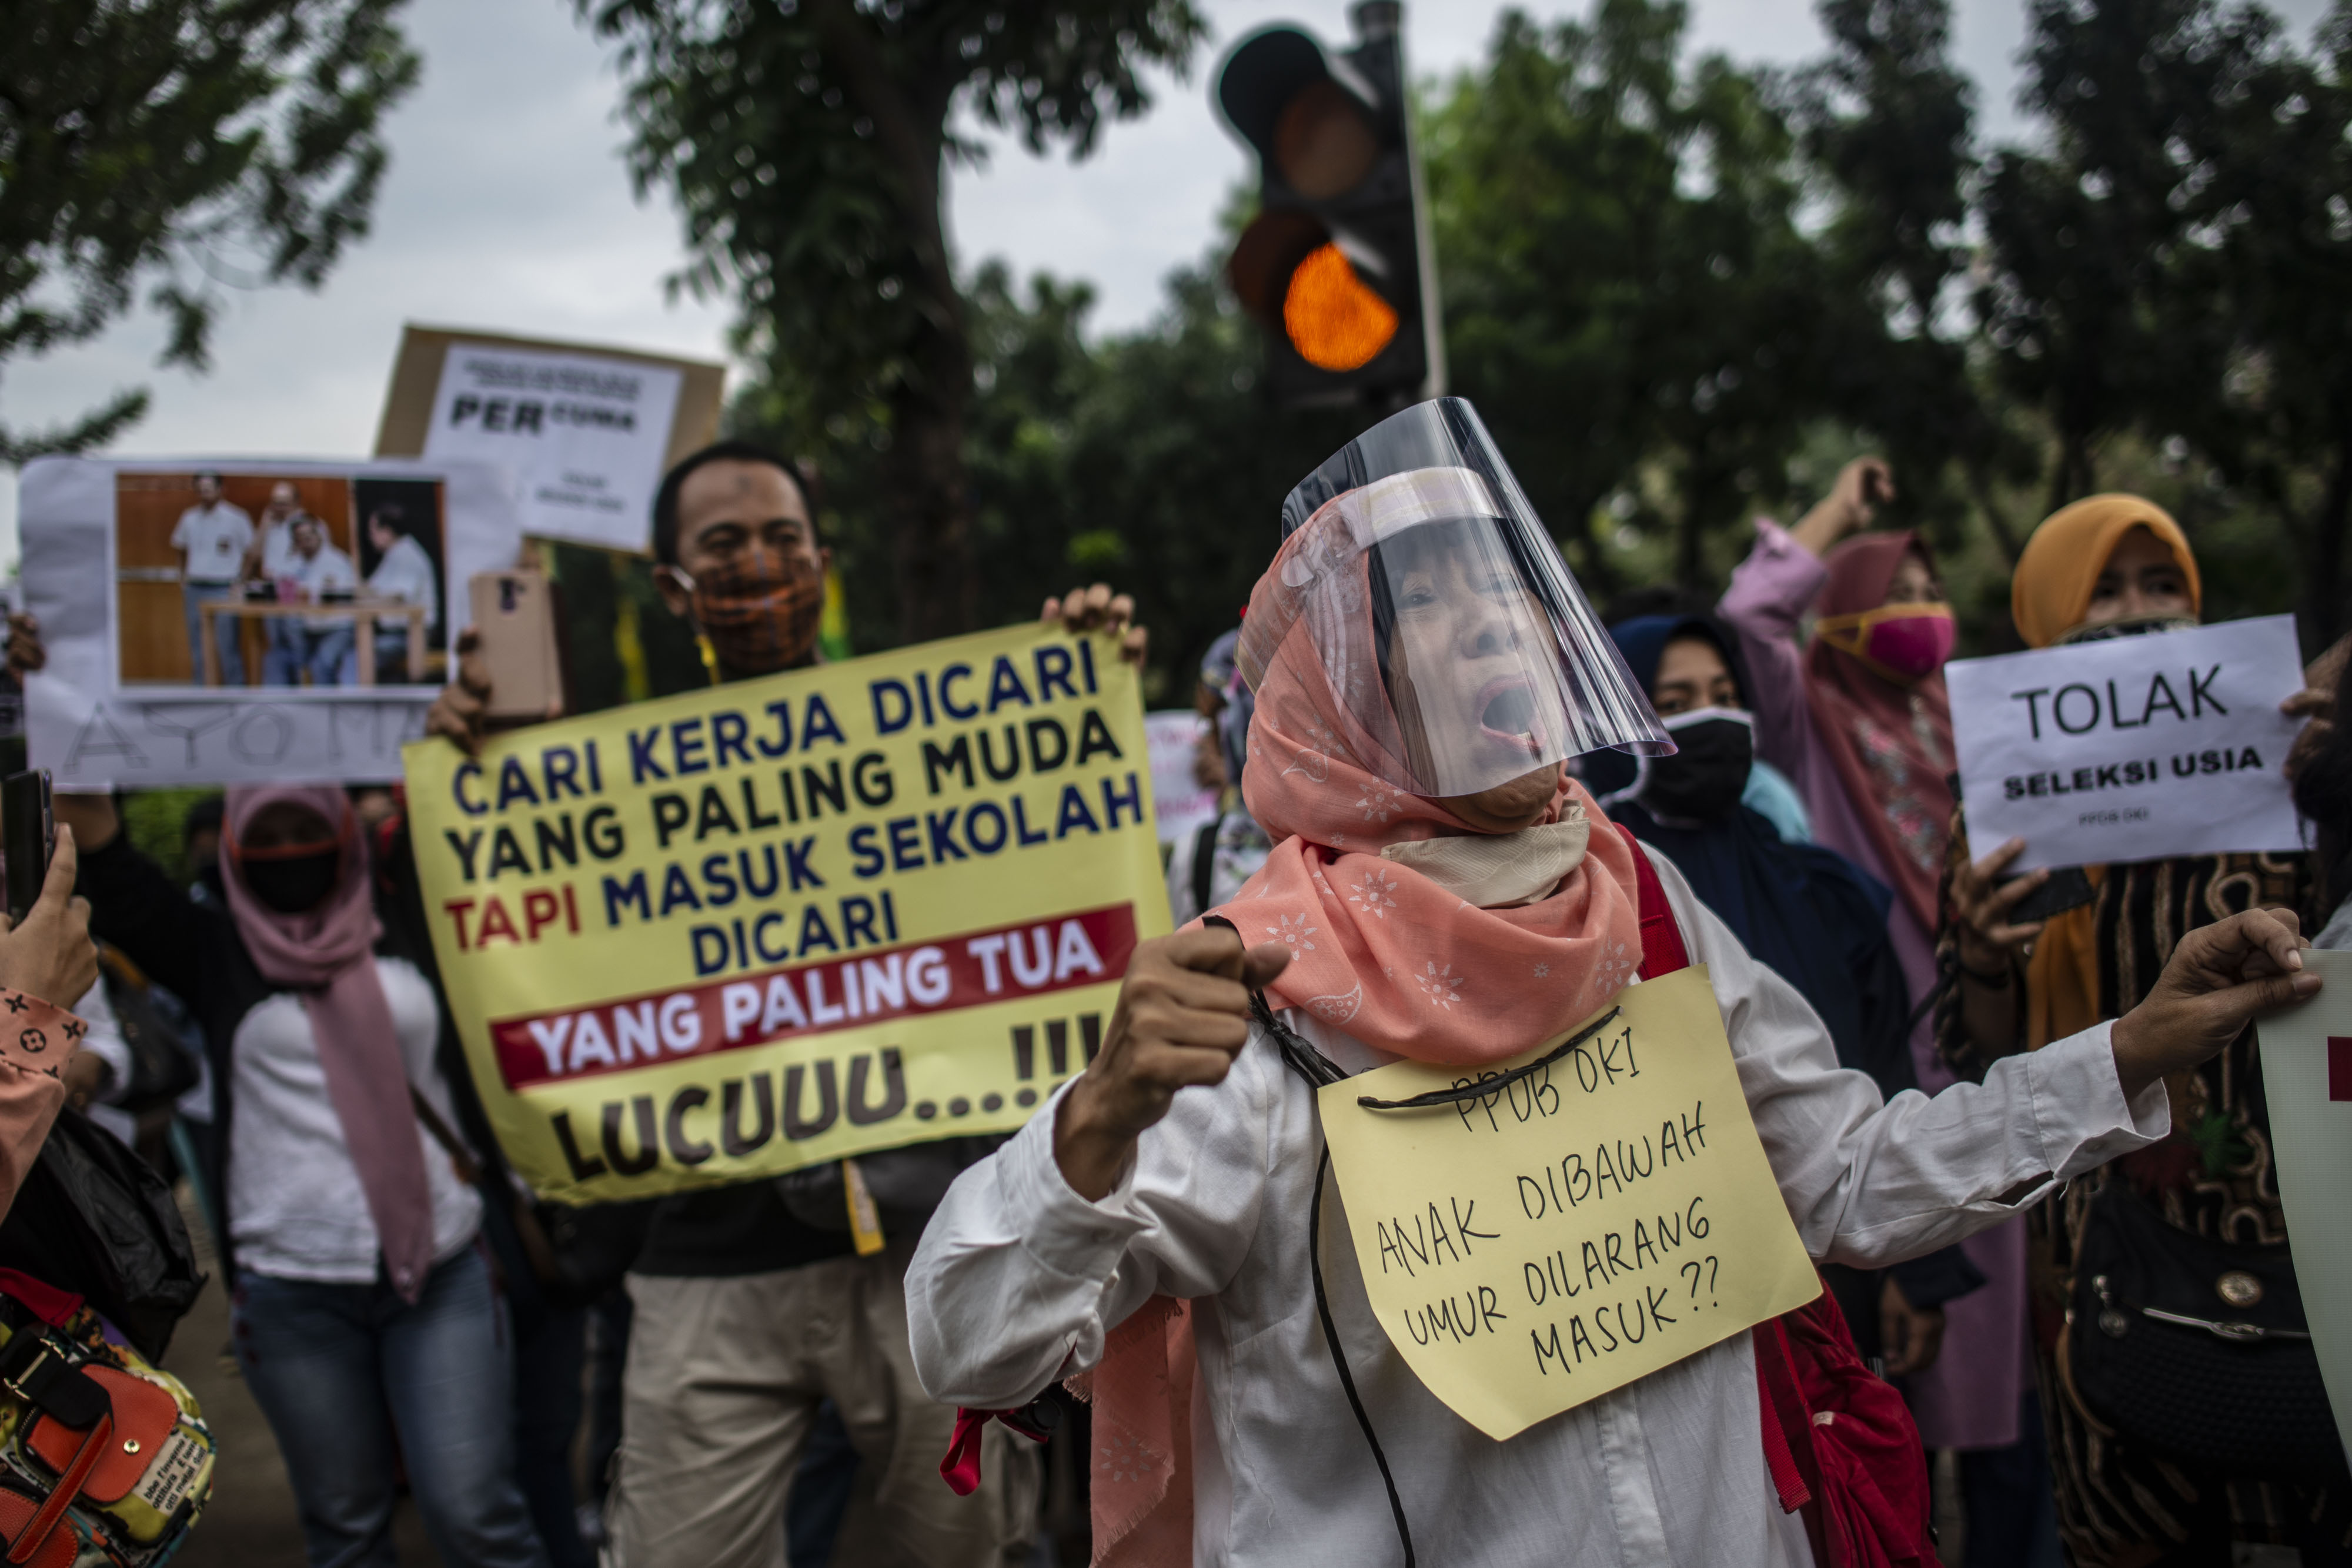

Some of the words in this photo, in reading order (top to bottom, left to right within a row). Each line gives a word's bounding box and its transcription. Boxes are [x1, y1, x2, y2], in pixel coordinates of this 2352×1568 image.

[452, 739, 602, 815] CARI
[627, 694, 846, 785] KERJA
[869, 638, 1099, 737] DICARI
[2004, 757, 2157, 800] SELEKSI
[2171, 746, 2263, 778] USIA
[2010, 663, 2229, 741] TOLAK
[443, 805, 625, 882] YANG
[651, 751, 894, 848] PALING
[920, 707, 1122, 795] MUDA
[443, 883, 580, 952] TAPI
[600, 835, 826, 928] MASUK
[848, 771, 1143, 878] SEKOLAH
[529, 993, 702, 1075] YANG
[721, 946, 951, 1041] PALING
[967, 920, 1104, 994] TUA
[690, 890, 898, 977] DICARI
[1377, 1197, 1501, 1276] ANAK
[1517, 1101, 1706, 1220] DIBAWAH
[1404, 1286, 1506, 1346] UMUR
[1524, 1196, 1710, 1306] DILARANG
